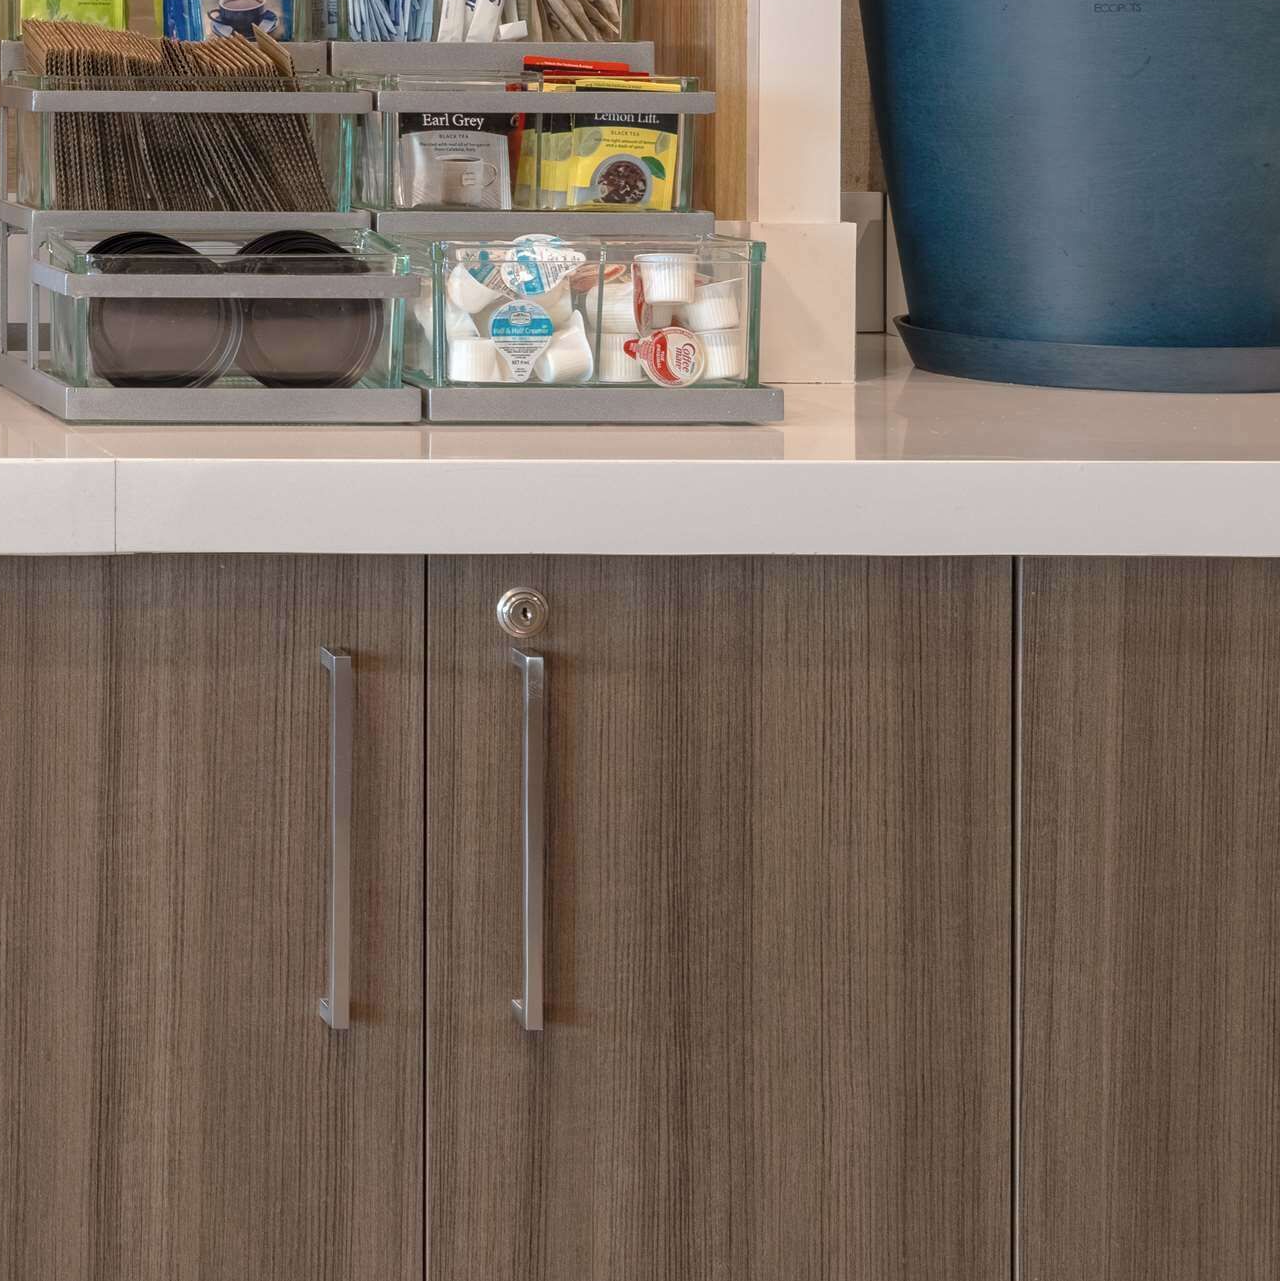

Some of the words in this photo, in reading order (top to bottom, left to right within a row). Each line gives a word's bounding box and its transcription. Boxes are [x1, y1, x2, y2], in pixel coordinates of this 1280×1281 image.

[422, 113, 450, 127] Earl
[452, 113, 485, 130] Grey
[594, 112, 635, 122] Lemon
[680, 343, 696, 373] Coffee
